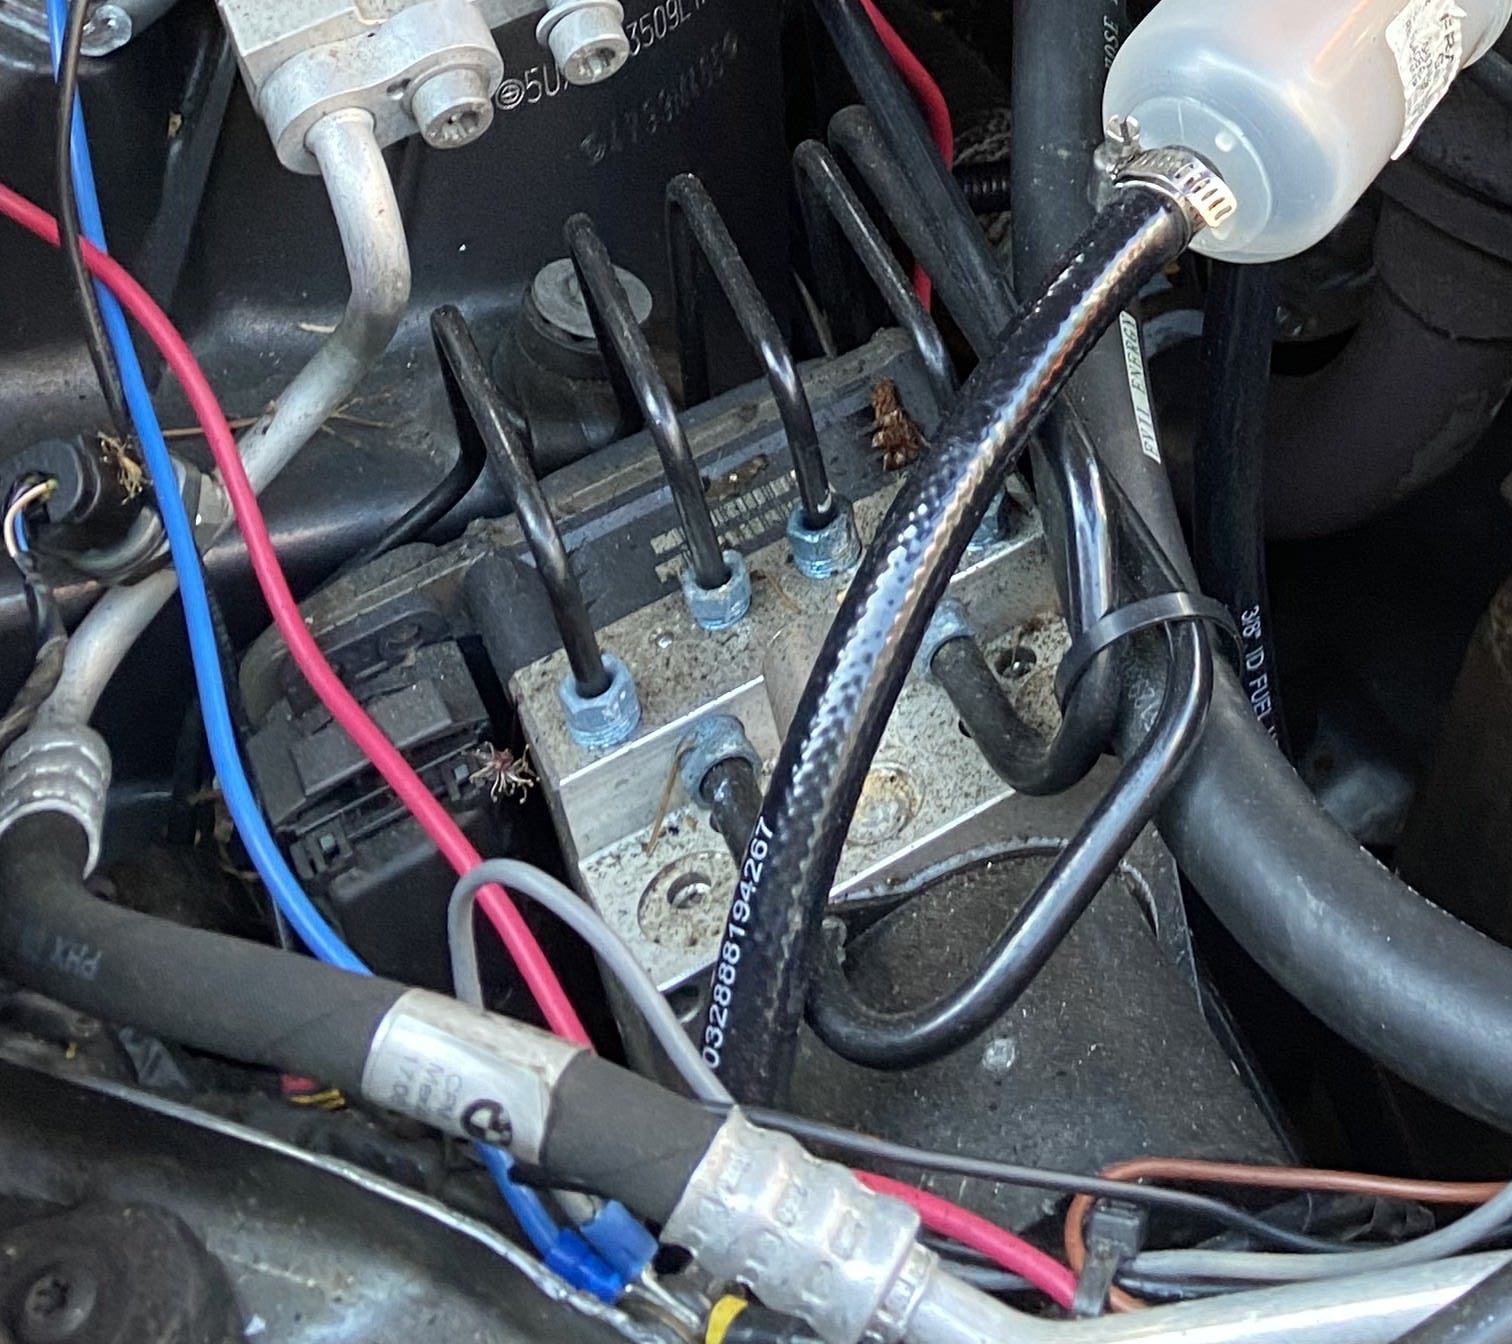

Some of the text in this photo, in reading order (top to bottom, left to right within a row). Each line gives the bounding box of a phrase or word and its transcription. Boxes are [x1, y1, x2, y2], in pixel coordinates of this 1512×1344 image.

[1121, 314, 1147, 393] ENERGY
[1246, 645, 1264, 670] ID
[703, 816, 775, 1069] 032888194267
